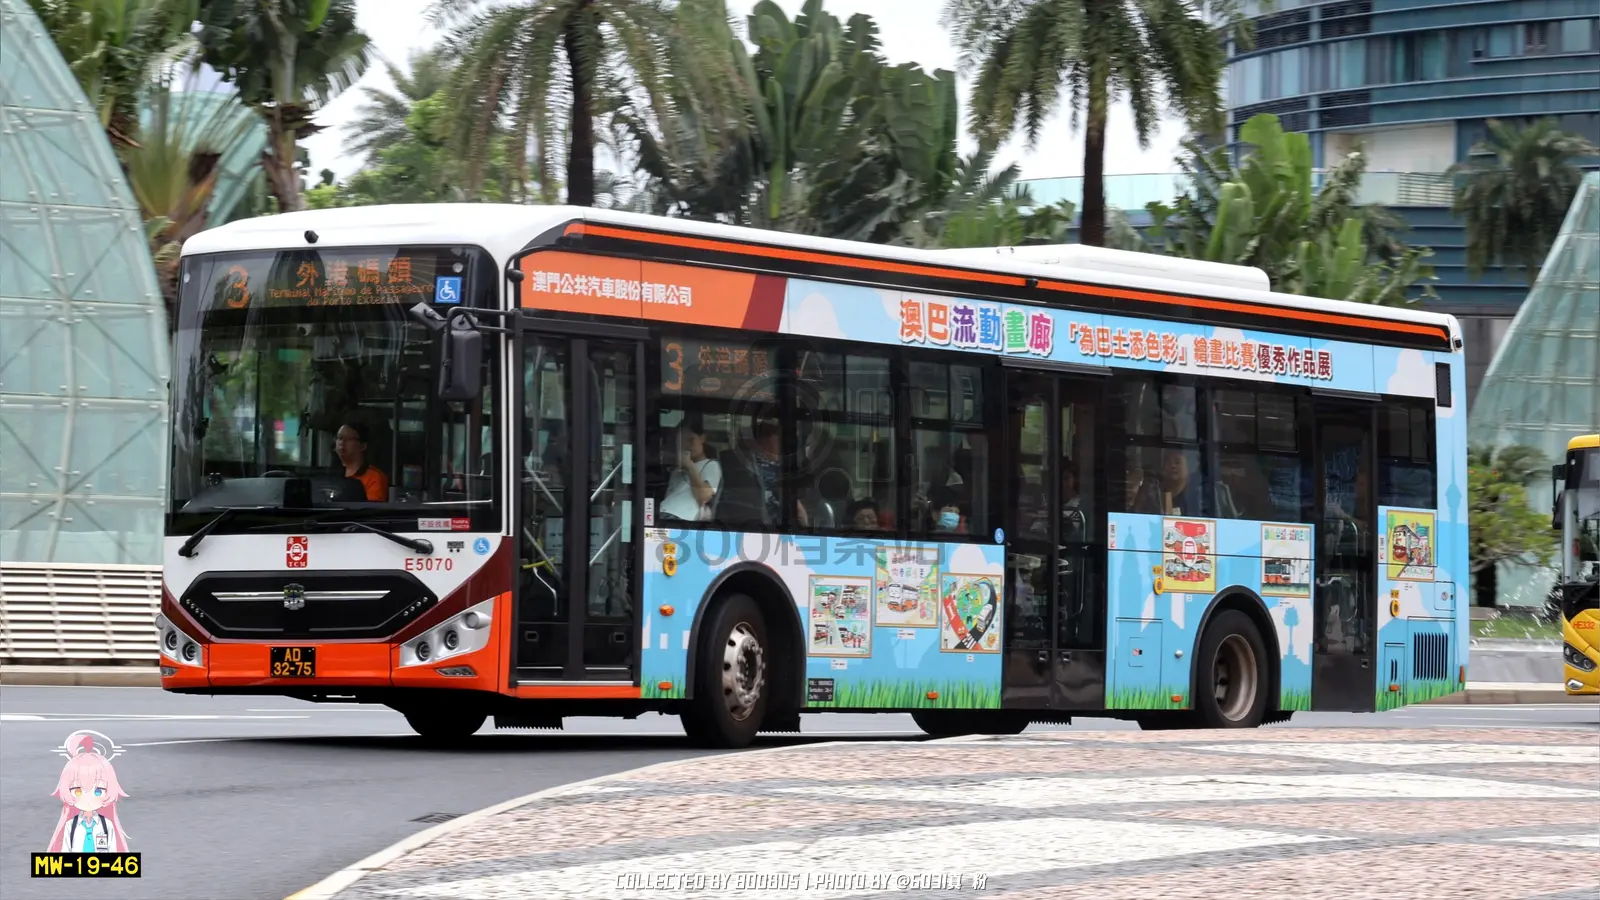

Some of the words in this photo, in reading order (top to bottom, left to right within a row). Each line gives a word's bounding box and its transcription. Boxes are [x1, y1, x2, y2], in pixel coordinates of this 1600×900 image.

[227, 265, 249, 308] 3
[532, 271, 692, 307] 澳門公共汽車股份有限公司
[899, 298, 1054, 355] 澳巴流動畫廊
[664, 342, 684, 391] 3
[405, 557, 453, 571] E5070
[1573, 621, 1595, 630] HE332
[284, 647, 301, 662] AD
[273, 661, 312, 676] 32-75
